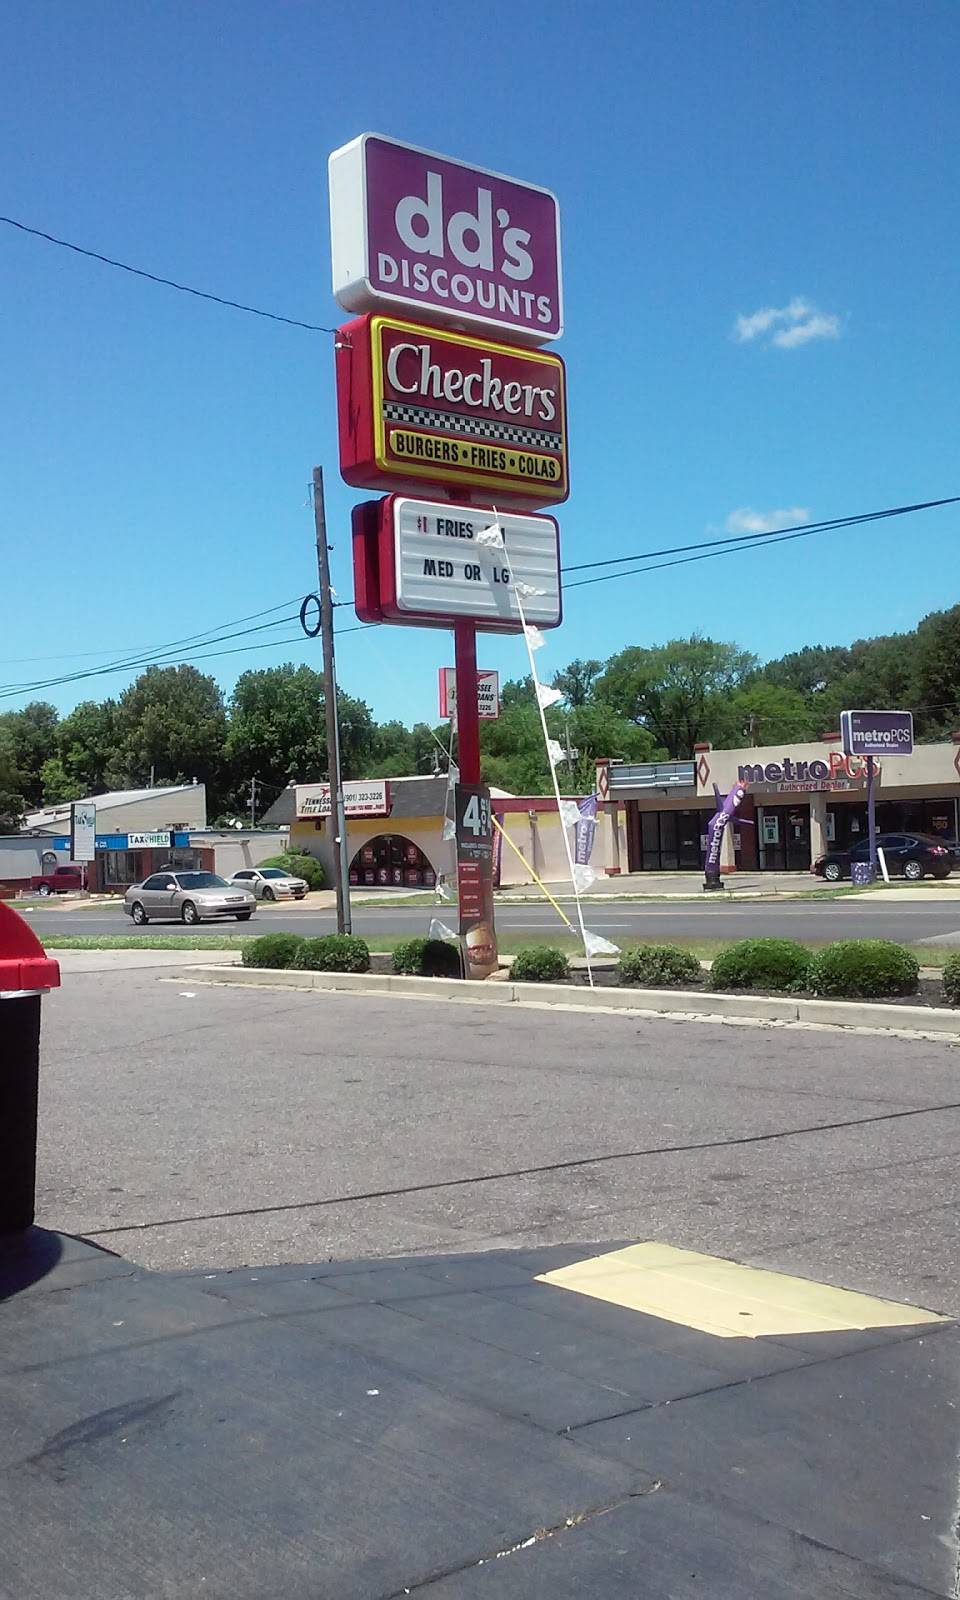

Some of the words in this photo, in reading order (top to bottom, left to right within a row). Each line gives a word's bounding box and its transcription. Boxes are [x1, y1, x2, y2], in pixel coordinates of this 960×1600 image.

[395, 170, 534, 281] dd's
[377, 252, 552, 324] DISCOUNTS
[386, 343, 556, 422] Checkers
[396, 433, 459, 463] BURGERS
[471, 446, 507, 471] FRIES
[518, 457, 556, 479] COLAS
[436, 518, 474, 539] FRIES
[423, 558, 454, 578] MED
[464, 564, 482, 582] OR
[493, 567, 510, 584] LG
[853, 728, 911, 742] metroPCS
[780, 783, 818, 791] Authorized
[821, 781, 846, 790] Dealer
[463, 795, 481, 836] 4
